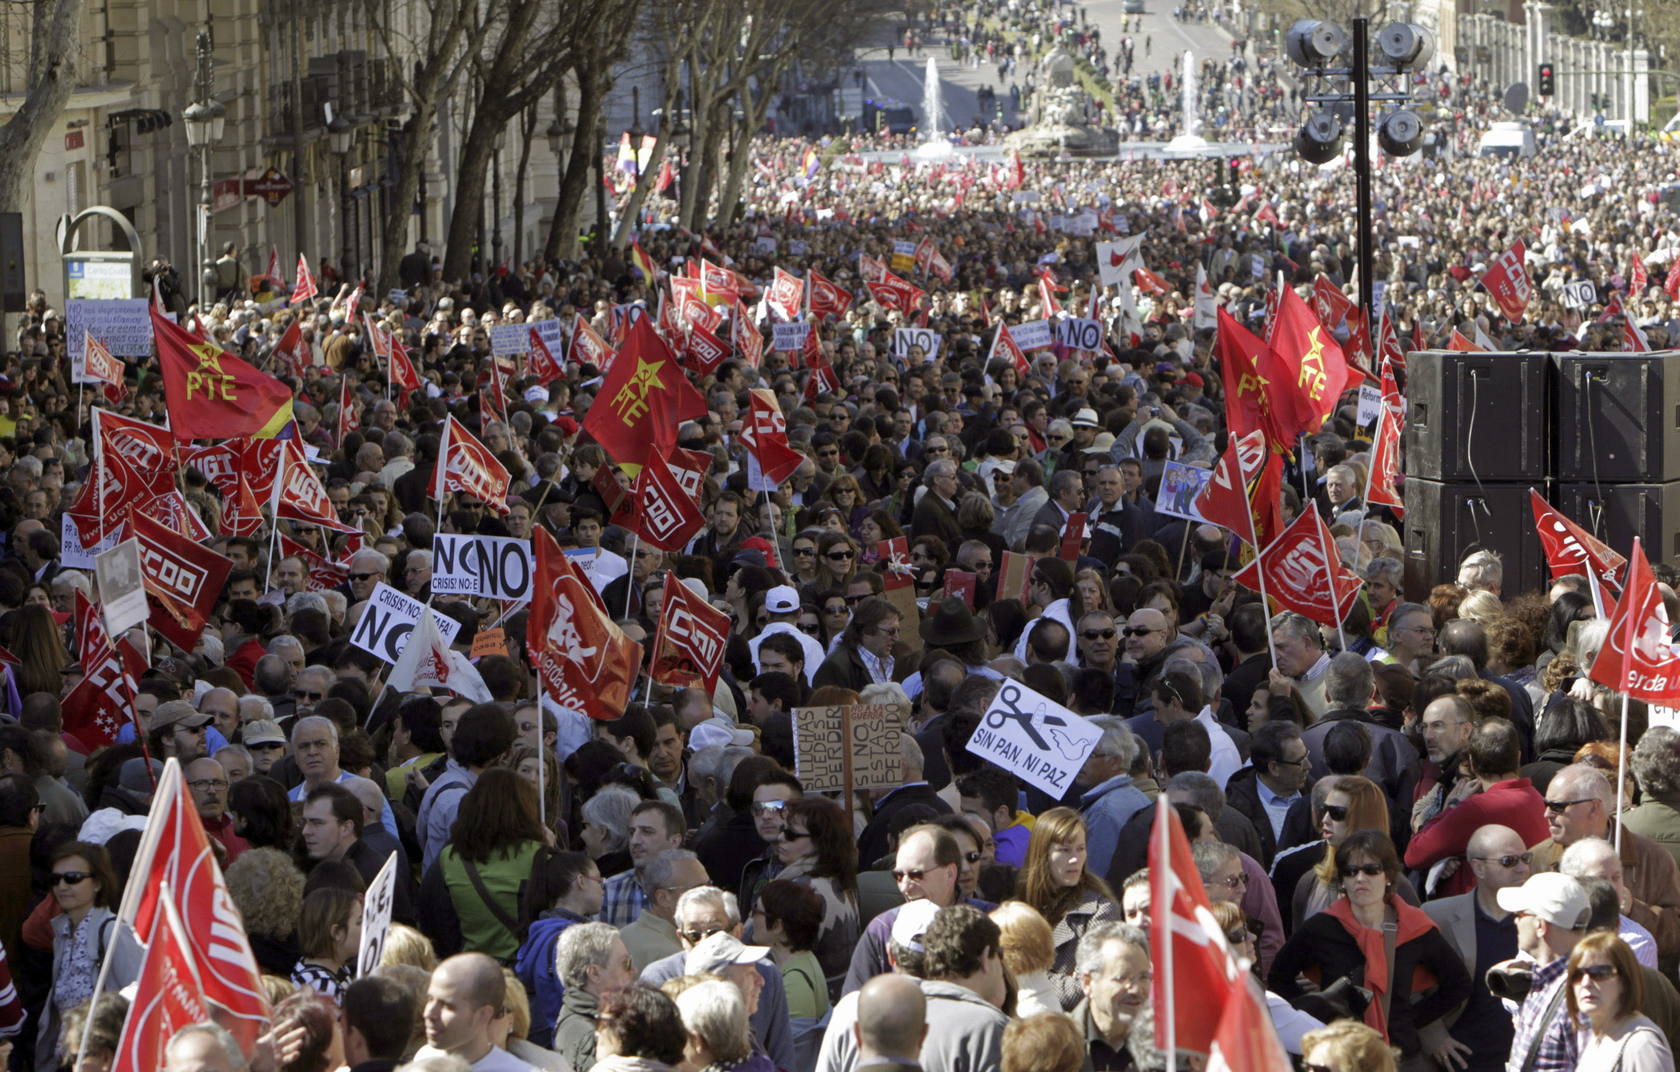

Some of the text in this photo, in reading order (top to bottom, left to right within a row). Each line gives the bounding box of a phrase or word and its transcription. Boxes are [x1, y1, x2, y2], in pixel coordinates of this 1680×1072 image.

[1565, 283, 1594, 305] NO
[69, 324, 83, 333] NO
[899, 331, 932, 355] NO
[1067, 319, 1100, 349] NO
[187, 371, 237, 401] PTE
[111, 433, 158, 473] UGT
[289, 468, 326, 513] UGT
[433, 577, 457, 590] CRISIS?
[459, 578, 473, 591] NO:
[475, 539, 529, 598] NO
[379, 589, 407, 614] CRISIS?
[799, 710, 816, 791] SI LUCHAS
[814, 720, 830, 789] PUEDES
[826, 706, 844, 788] PERDER
[854, 723, 871, 757] NO
[869, 719, 884, 784] ESTAS
[884, 703, 904, 783] PERDIDO
[973, 728, 1067, 790] SIN PAN, NI PAZ.
